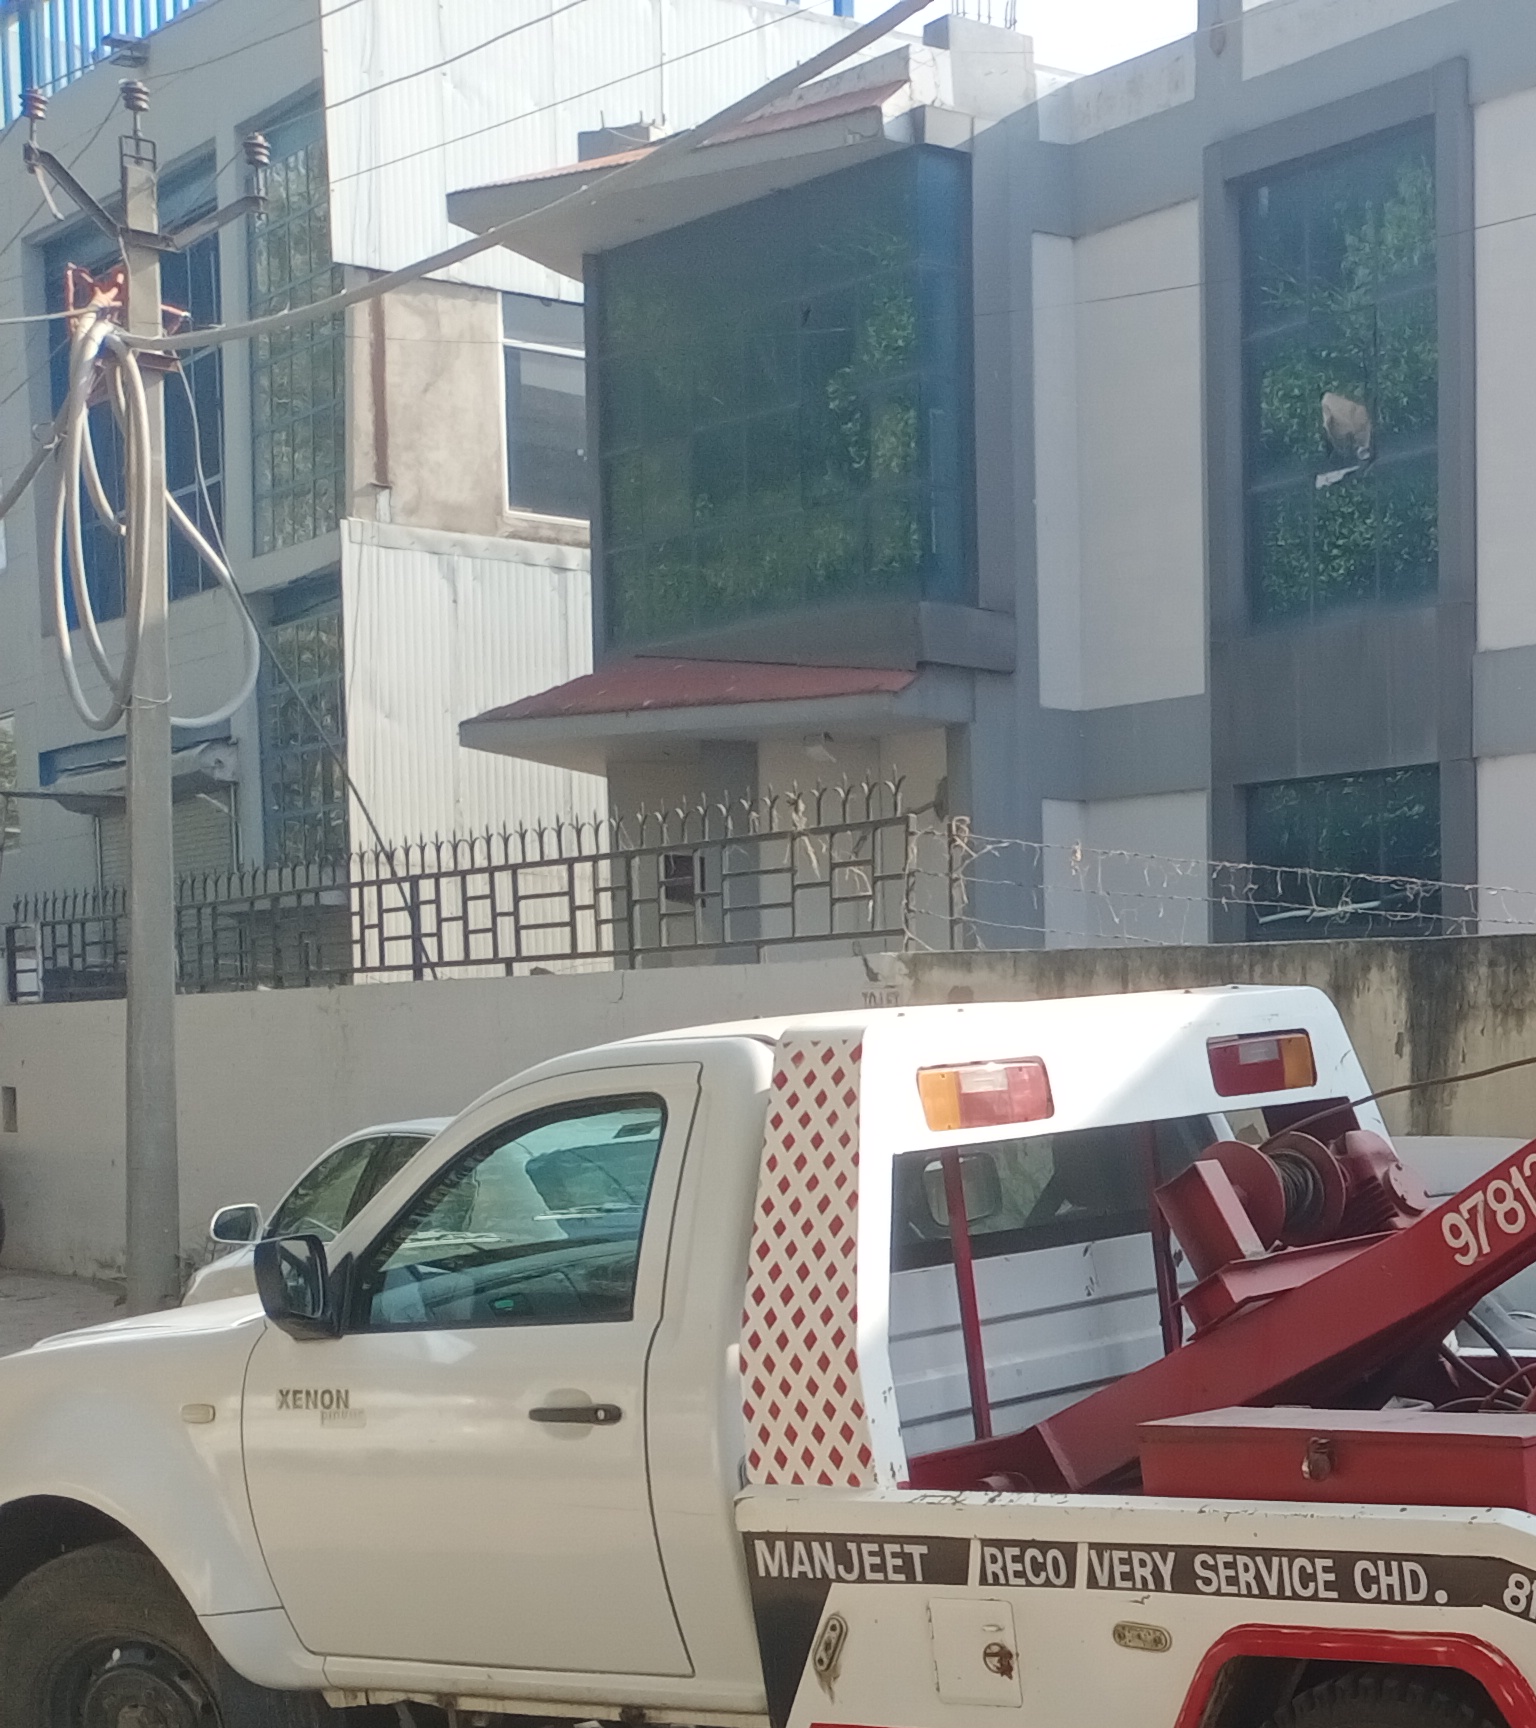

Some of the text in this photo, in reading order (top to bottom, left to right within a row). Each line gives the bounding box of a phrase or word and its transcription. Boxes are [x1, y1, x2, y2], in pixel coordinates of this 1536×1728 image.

[277, 1388, 350, 1410] XENON
[753, 1538, 1449, 1605] MANJEET RECO VERY SERVICE CHD.
